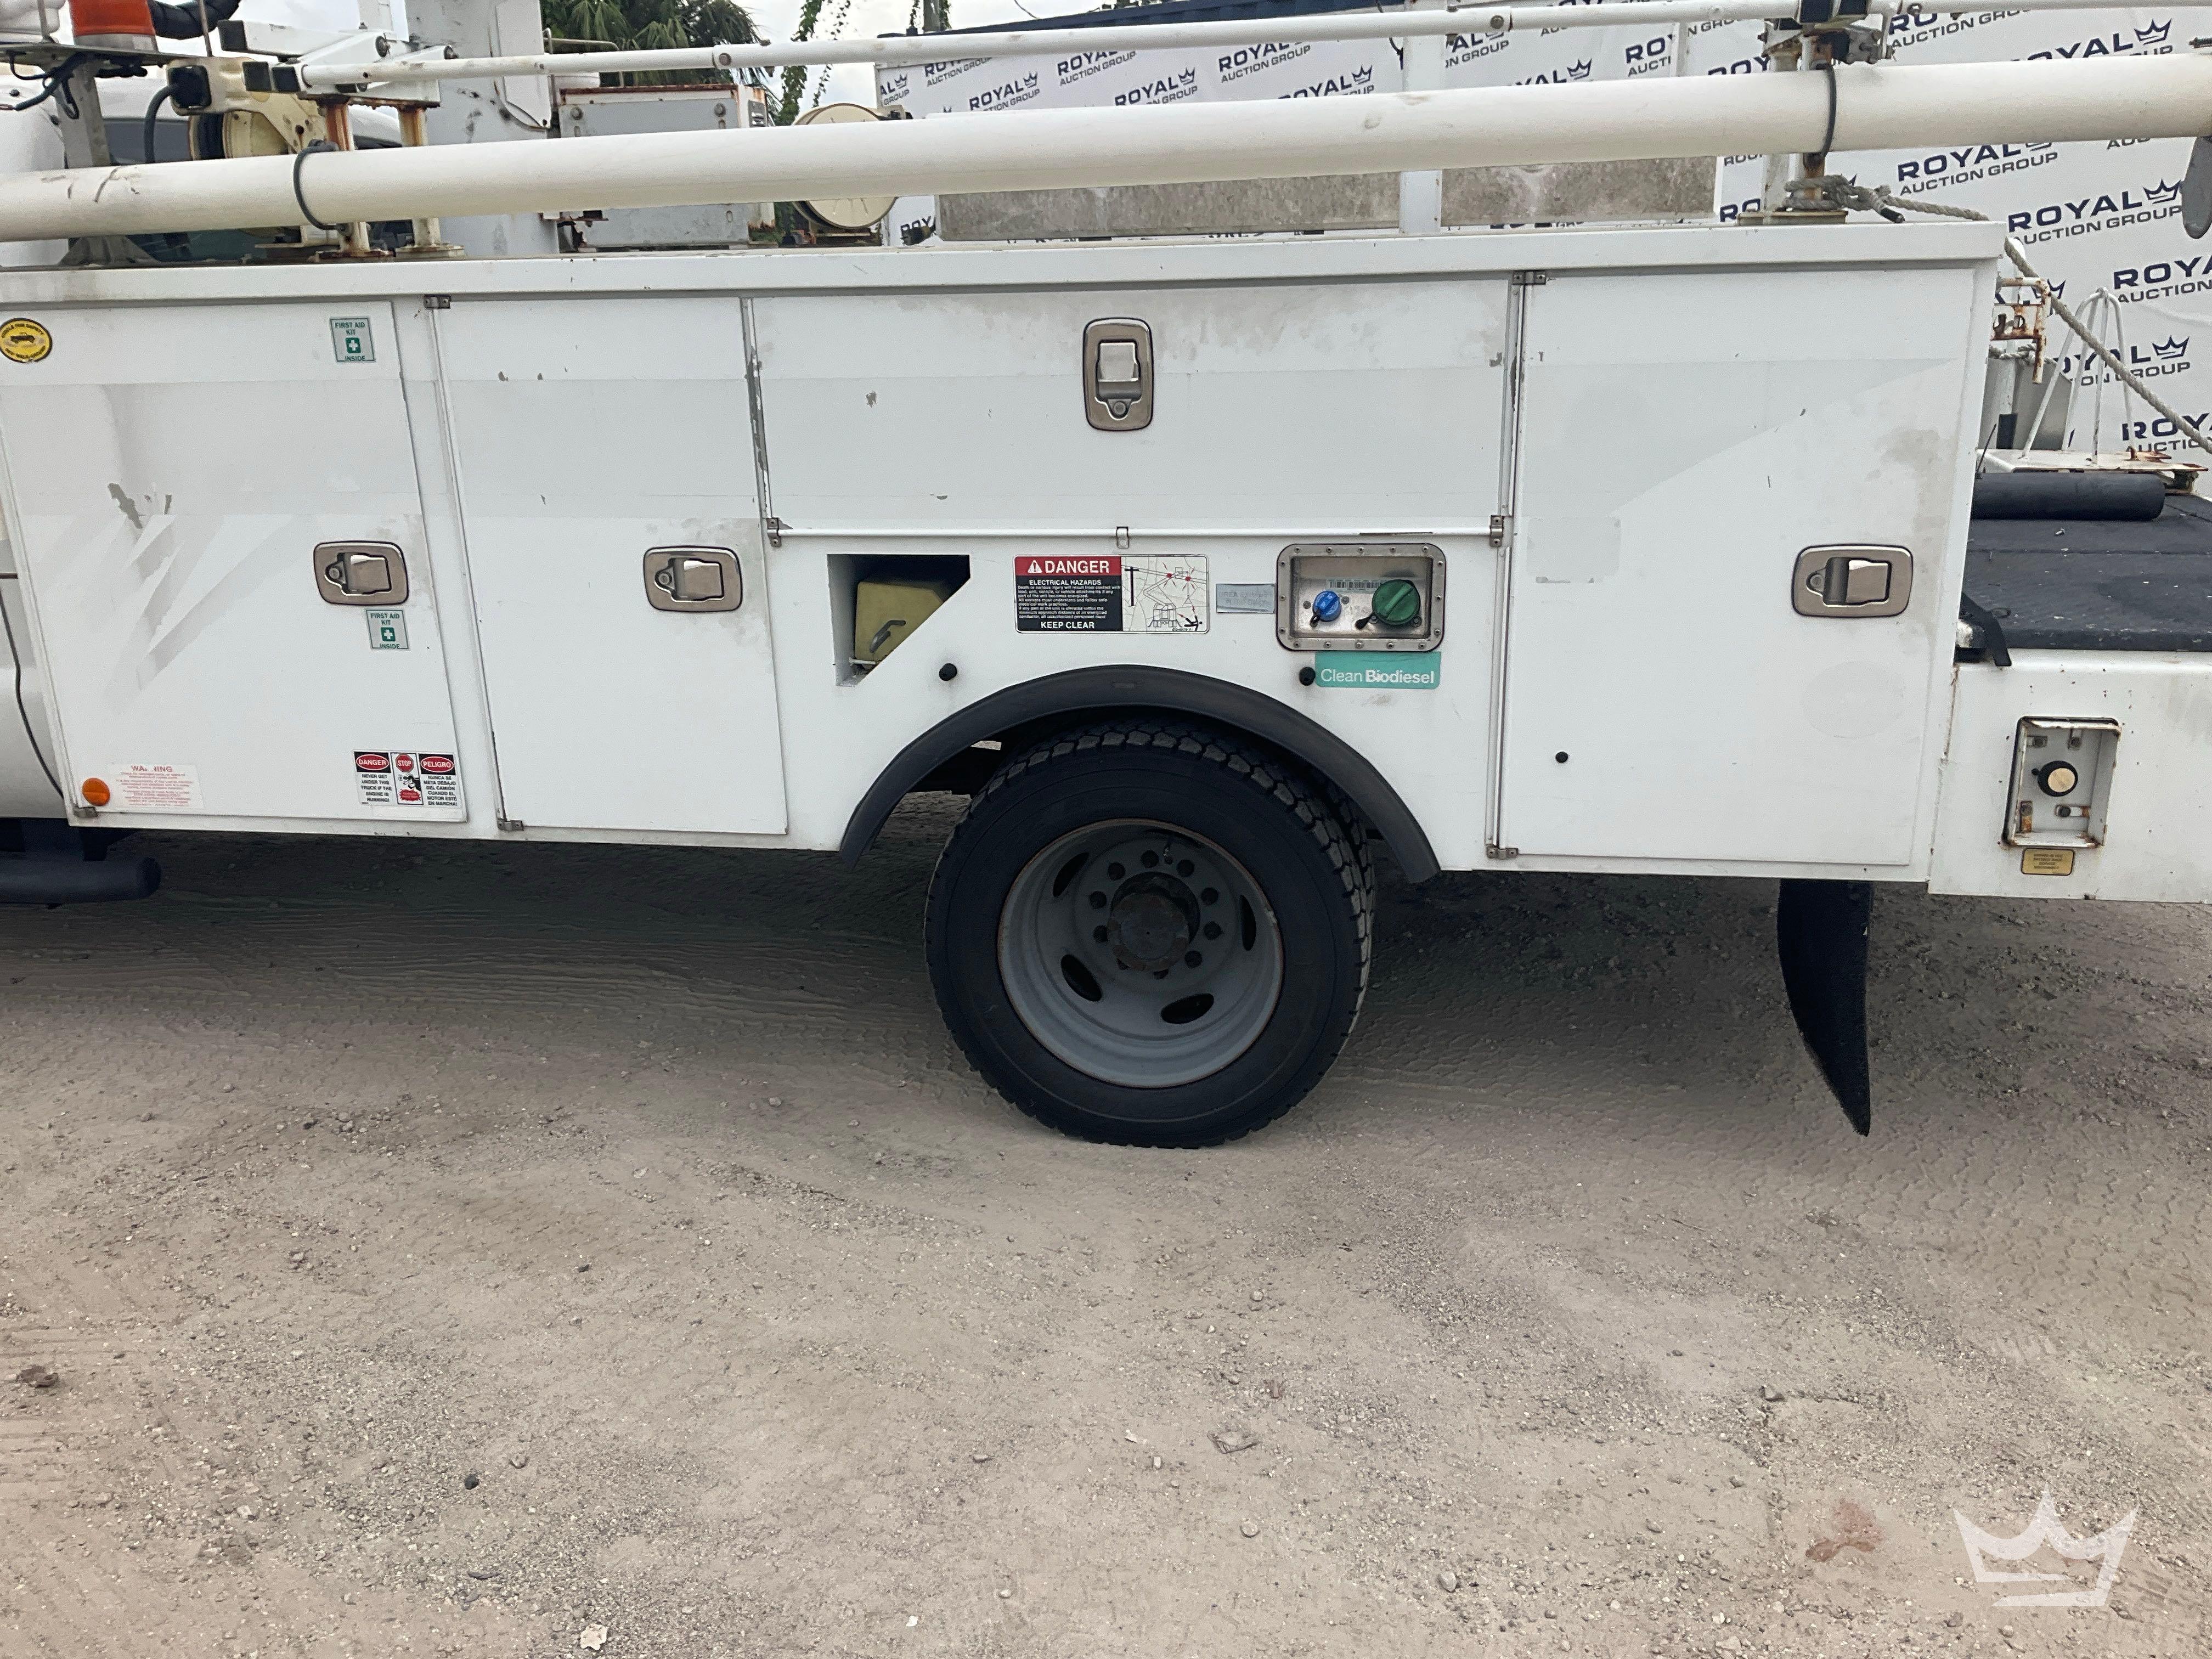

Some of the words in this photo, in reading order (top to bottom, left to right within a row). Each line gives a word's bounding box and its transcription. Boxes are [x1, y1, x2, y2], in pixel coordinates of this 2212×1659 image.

[1892, 18, 1974, 48] AUCTION
[1221, 59, 1269, 83] AUCTION
[1271, 44, 1311, 65] GROUP
[1462, 40, 1509, 63] GROUP
[927, 67, 962, 87] AUCTION
[1060, 64, 1101, 86] AUCTION
[1102, 51, 1136, 70] GROUP
[1628, 56, 1671, 77] AUCTI
[884, 89, 910, 105] GROUP
[969, 80, 1024, 111] ROYAL
[1010, 88, 1040, 106] GROUP
[1115, 77, 1179, 106] ROYAL
[1162, 85, 1198, 104] GROUP
[1278, 75, 1352, 99] OYAL
[1898, 144, 2021, 182] ROYAL
[1900, 168, 1983, 196] AUCTION
[1988, 152, 2058, 176] GROUP
[2008, 190, 2142, 232] ROYAL
[2106, 205, 2182, 228] GROUP
[2118, 279, 2212, 303] AUCTION
[2121, 413, 2212, 441] ROY
[1045, 560, 1109, 573] DANGER
[1321, 669, 1362, 682] Clean
[1365, 669, 1434, 684] Biodiesel
